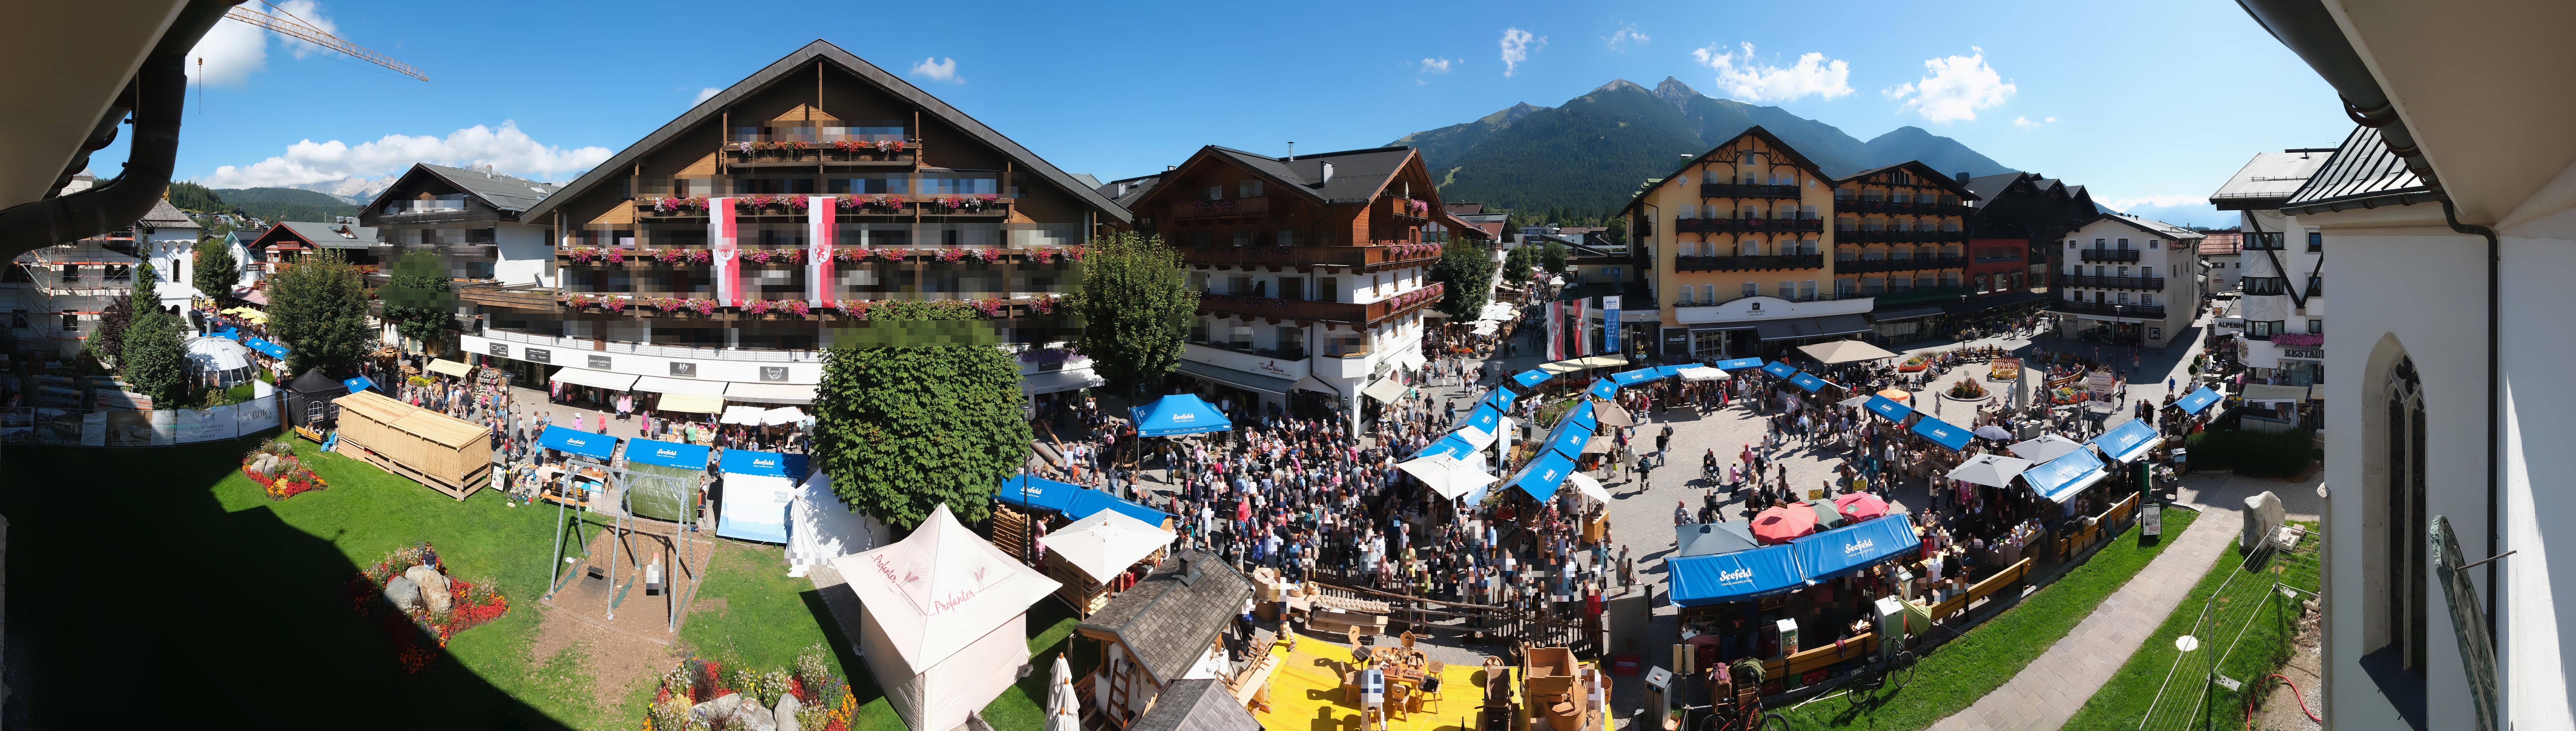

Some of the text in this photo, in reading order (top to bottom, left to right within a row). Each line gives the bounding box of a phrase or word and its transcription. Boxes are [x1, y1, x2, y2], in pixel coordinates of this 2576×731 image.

[1406, 344, 1415, 353] SAILER
[2238, 356, 2249, 366] Kaltschmid
[677, 363, 689, 373] My
[1376, 366, 1390, 378] RESTAURANT
[2120, 433, 2133, 442] Seefeld
[1543, 469, 1555, 481] Seefeld
[2056, 465, 2074, 476] Seefeld
[1845, 538, 1873, 553] Seefeld
[874, 554, 896, 583] Profanter
[1719, 567, 1752, 582] Seefeld
[987, 575, 1016, 593] NATUR-BACKSTUBE
[900, 592, 923, 617] NATUR-BACKSTUBE
[934, 590, 976, 615] Profanter
